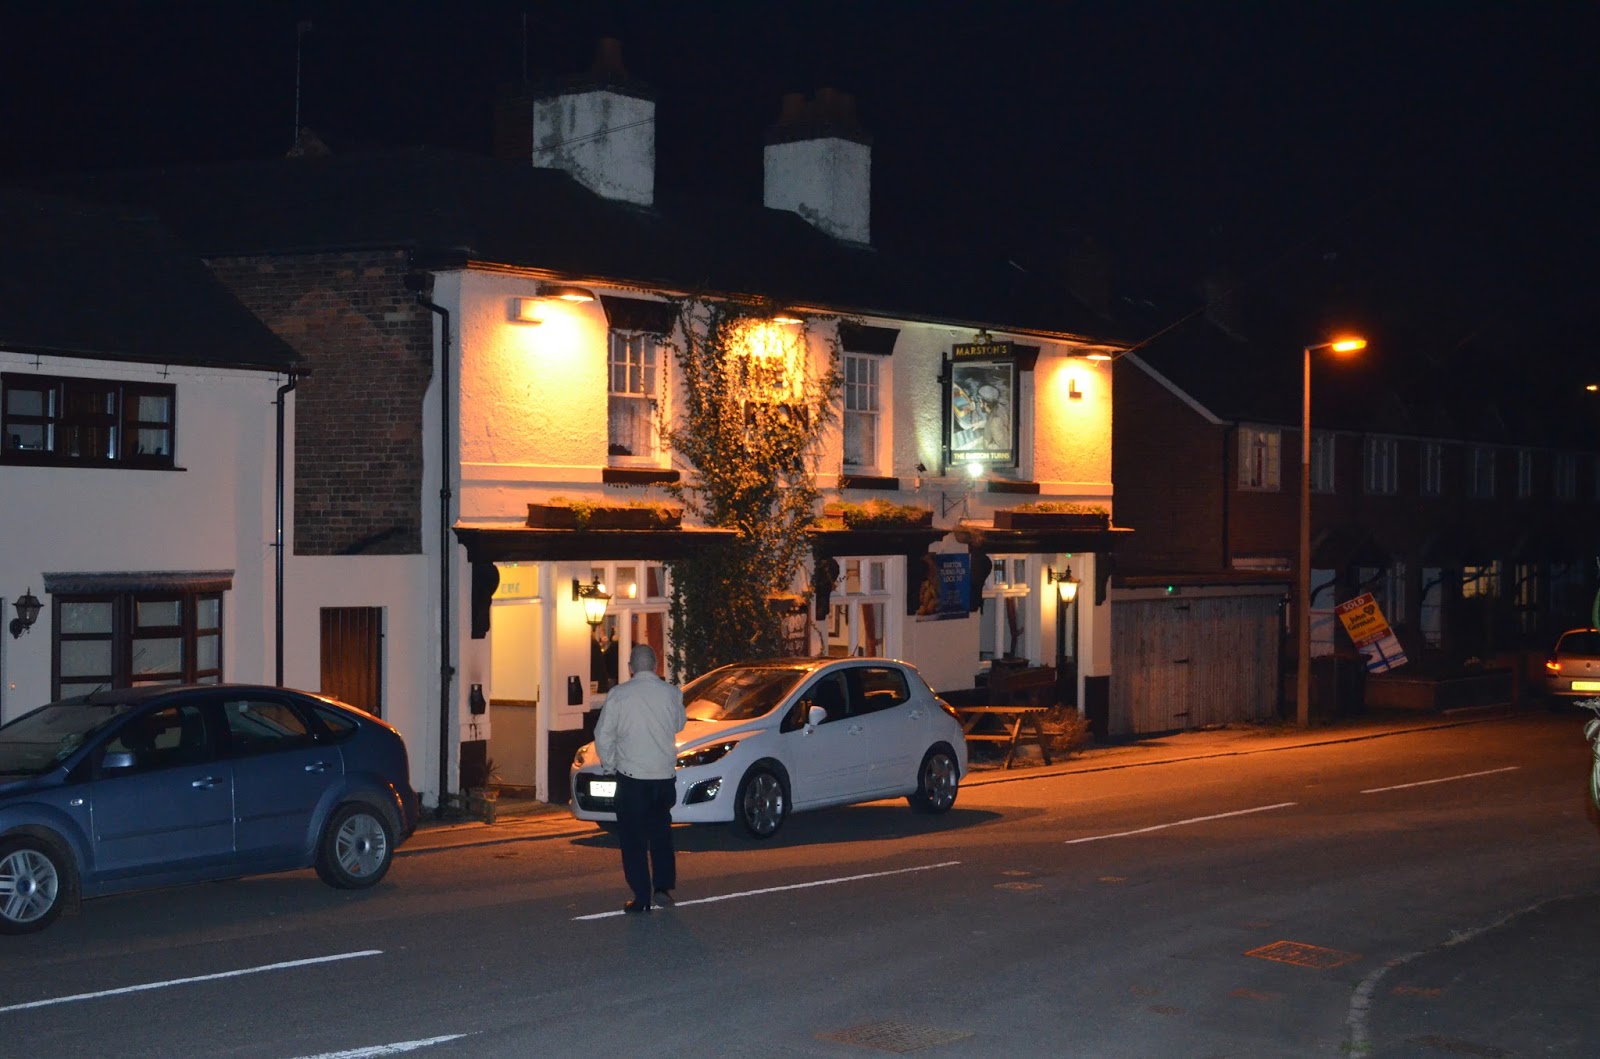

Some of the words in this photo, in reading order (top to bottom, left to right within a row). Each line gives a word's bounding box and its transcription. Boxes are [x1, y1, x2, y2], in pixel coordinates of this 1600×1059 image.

[956, 345, 1008, 356] MARSTON'S
[940, 568, 955, 576] TURNS
[943, 575, 956, 583] LOCK
[1342, 598, 1365, 612] SOLD
[1347, 616, 1376, 630] German
[1349, 613, 1367, 624] John
